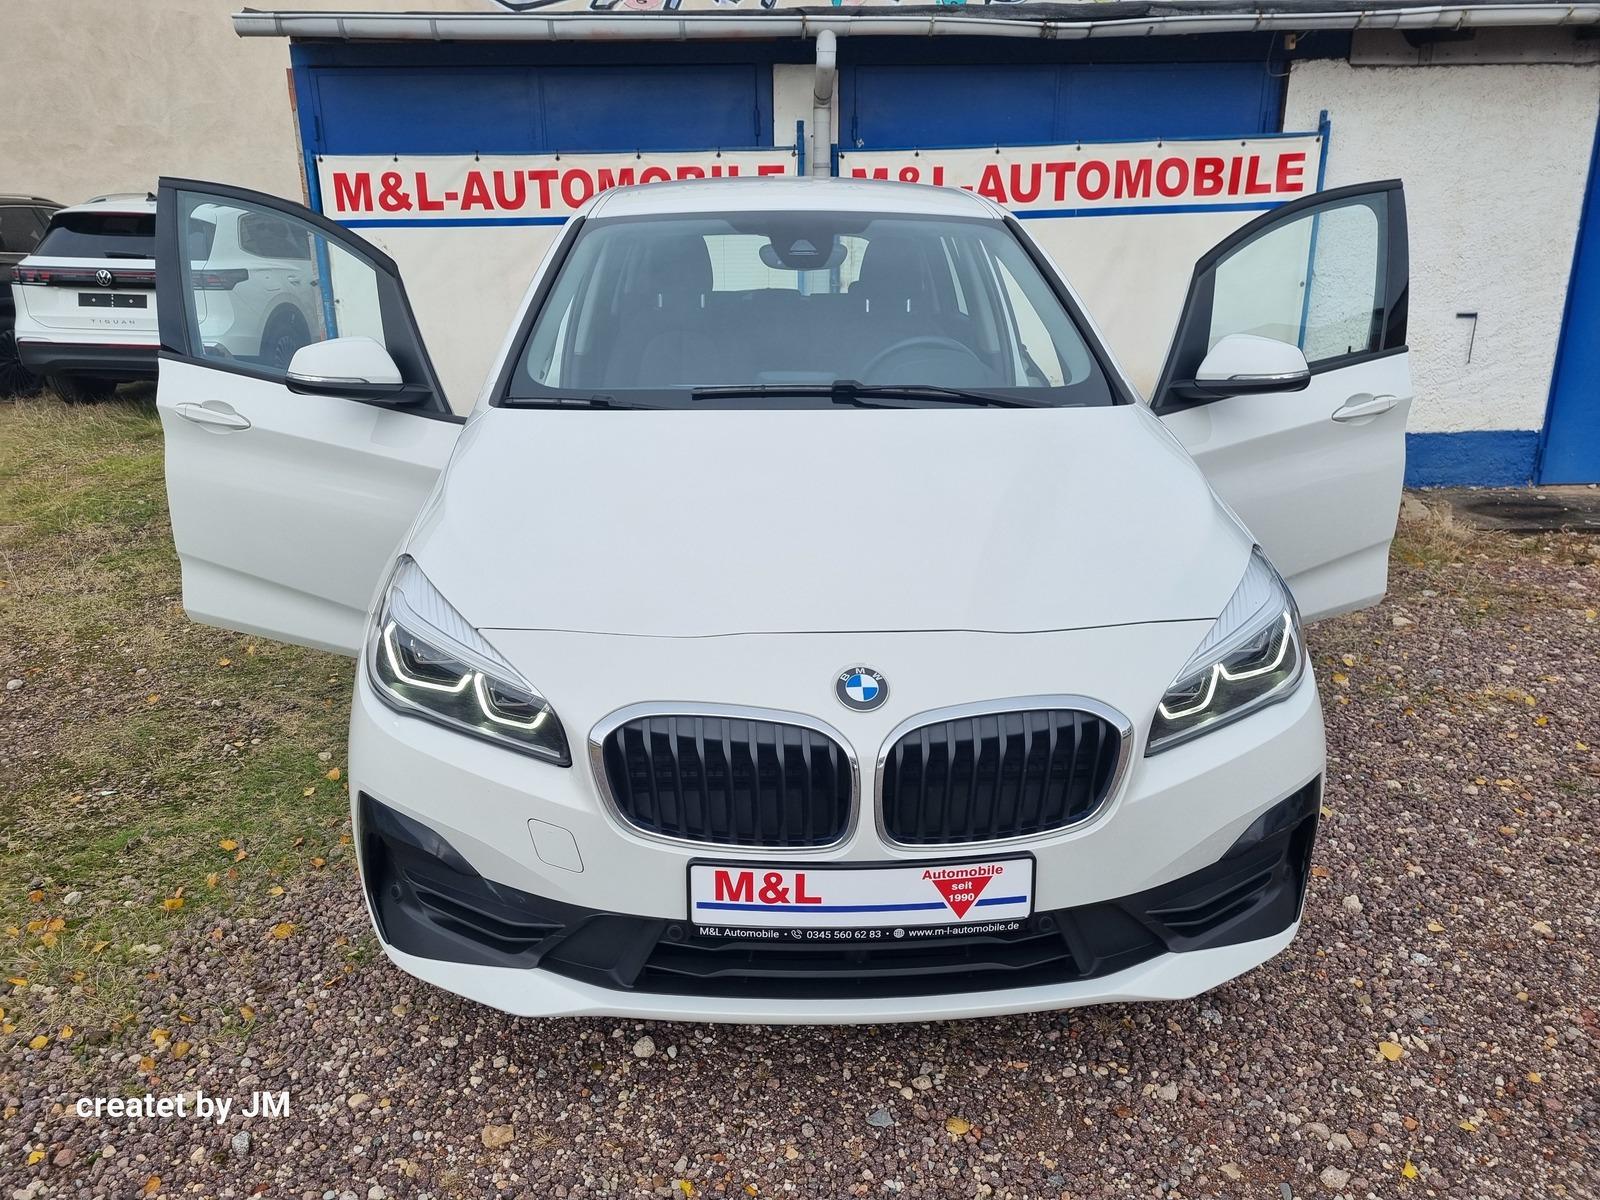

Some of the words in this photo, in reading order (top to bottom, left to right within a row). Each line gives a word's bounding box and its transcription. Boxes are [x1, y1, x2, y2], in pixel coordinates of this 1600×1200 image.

[852, 153, 1306, 203] AUTOMOBILE
[333, 165, 785, 212] M&L-AUTO
[840, 667, 882, 681] BMW
[922, 865, 1004, 880] Automobile
[714, 870, 822, 905] M&L
[951, 881, 973, 891] seit
[948, 892, 975, 903] 1990
[699, 927, 722, 936] M&L
[724, 928, 780, 939] Automobile
[806, 930, 832, 939] 0345
[833, 930, 852, 939] 560
[854, 930, 867, 939] 62
[868, 930, 882, 938] 83
[908, 922, 1020, 937] www.m-l-automobile.de
